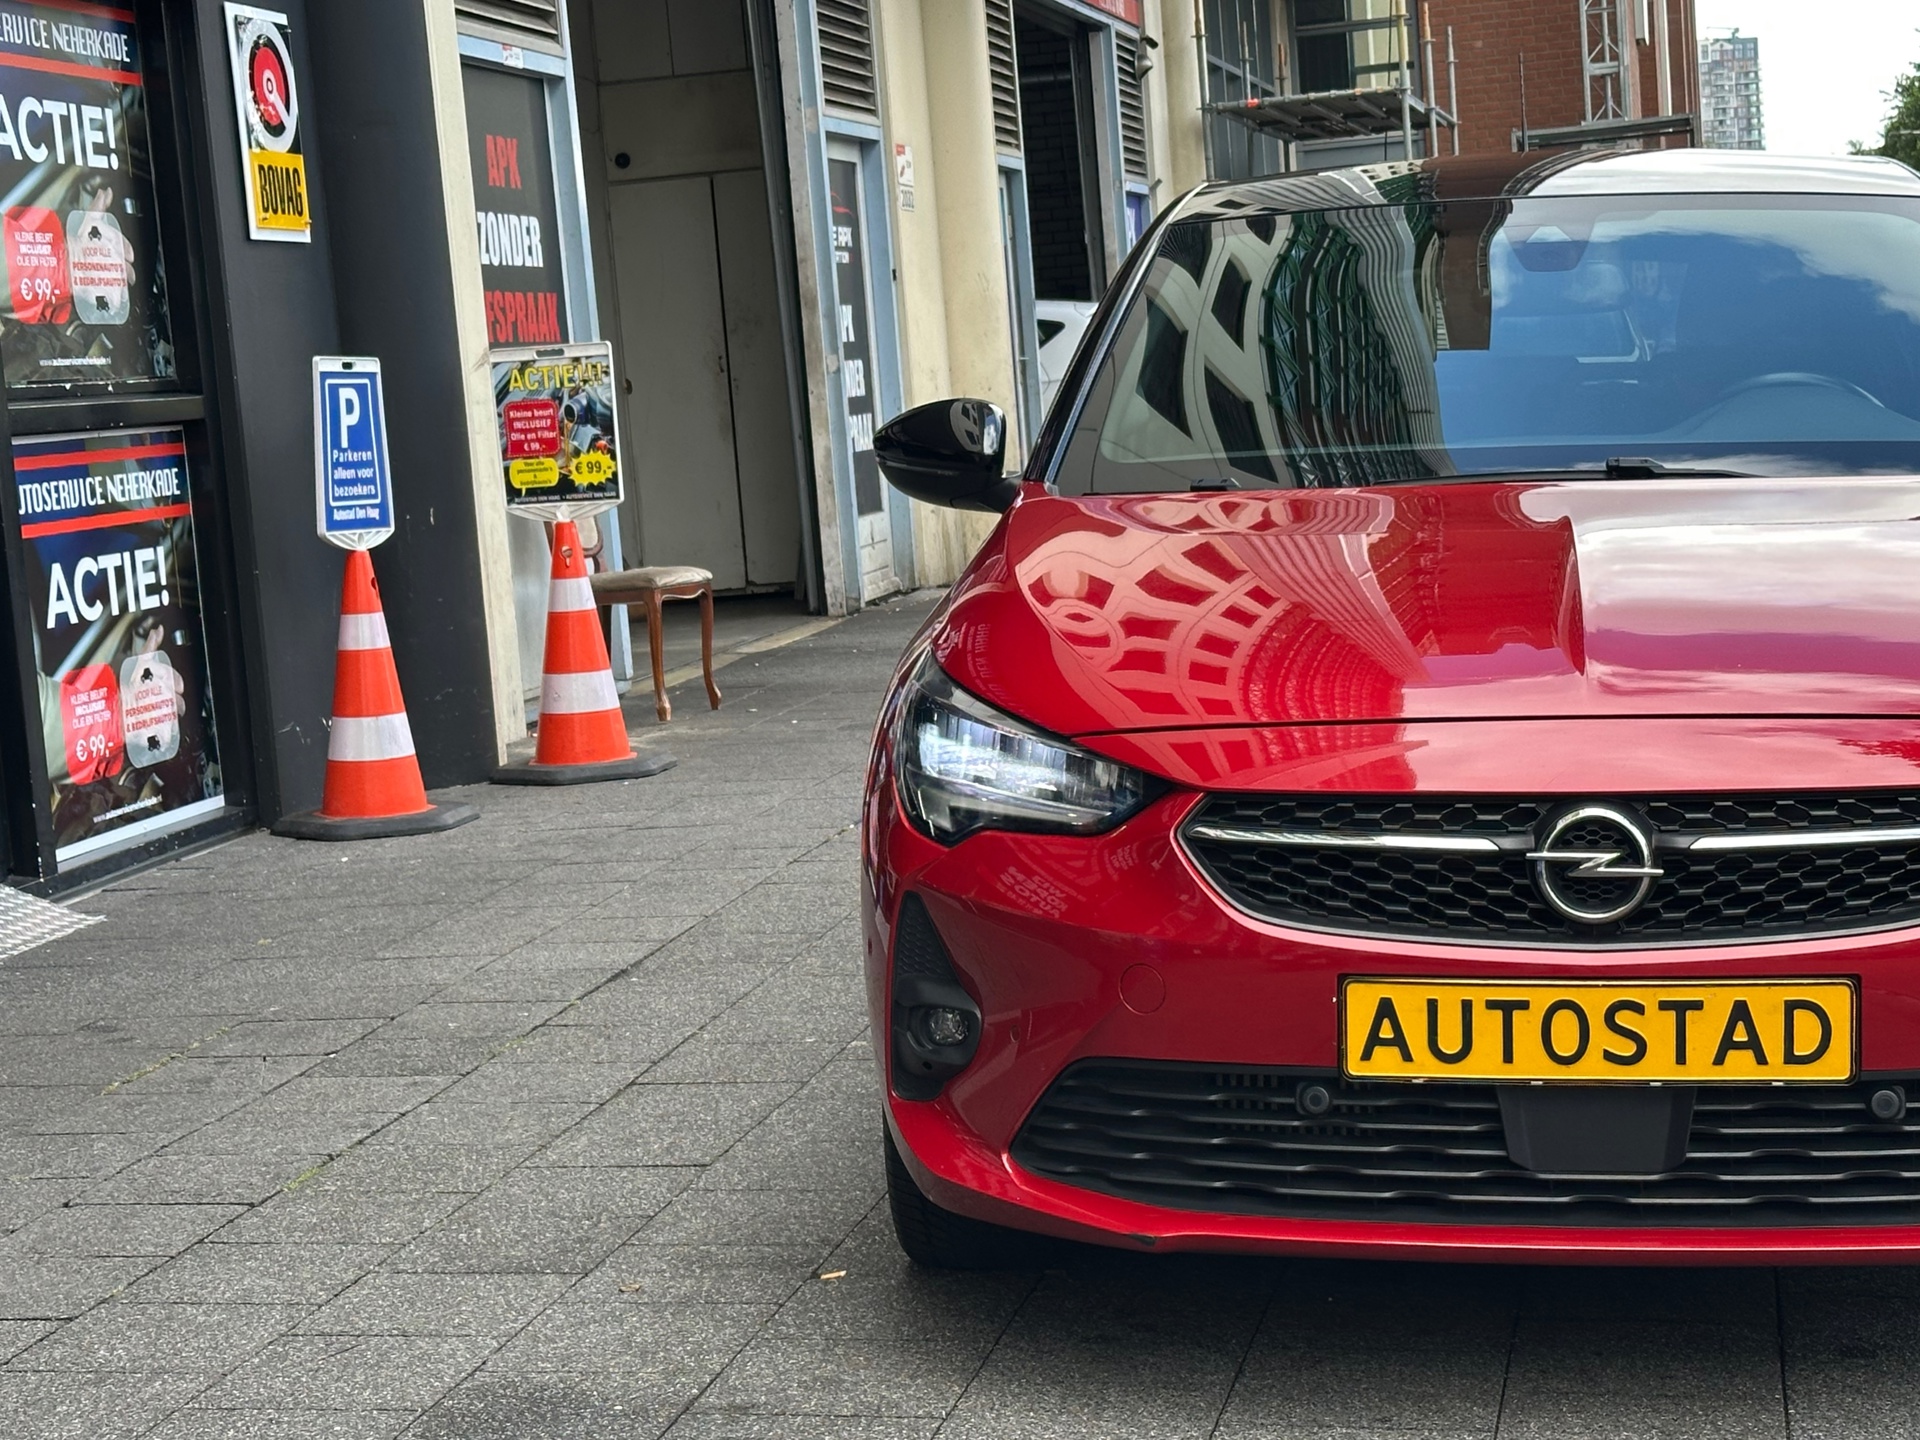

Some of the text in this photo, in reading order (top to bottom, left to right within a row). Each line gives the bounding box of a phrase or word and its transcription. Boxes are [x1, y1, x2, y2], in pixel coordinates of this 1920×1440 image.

[51, 21, 130, 62] NEHERKADE
[486, 134, 522, 189] APK
[258, 164, 304, 217] BOVAG
[476, 211, 544, 268] ZONDER
[20, 278, 60, 304] € 99,-
[338, 387, 360, 448] P
[513, 418, 552, 430] INCLUSIEF
[534, 408, 554, 417] beurt
[538, 430, 557, 439] Filter
[333, 449, 372, 463] Parkeren
[576, 461, 612, 475] € 99,-
[106, 468, 181, 503] NEHERKADE
[334, 467, 374, 479] alleen voor
[334, 484, 376, 497] bezoekers
[46, 546, 170, 629] ACTIE!
[76, 734, 114, 762] € 99,-
[1360, 996, 1832, 1066] AUTOSTAD
